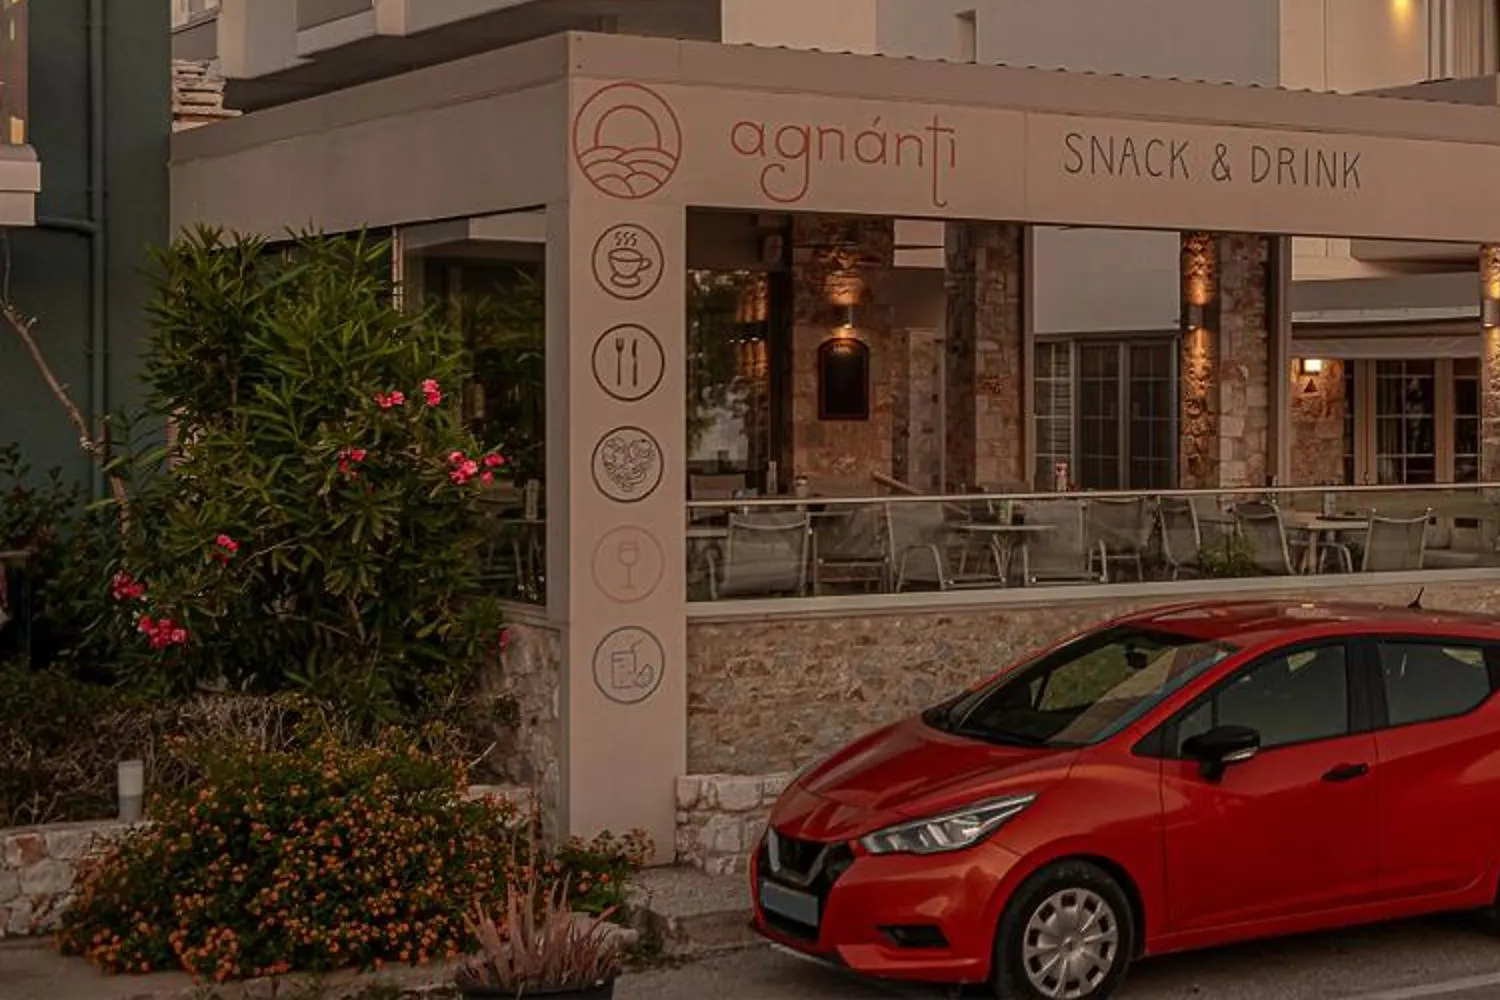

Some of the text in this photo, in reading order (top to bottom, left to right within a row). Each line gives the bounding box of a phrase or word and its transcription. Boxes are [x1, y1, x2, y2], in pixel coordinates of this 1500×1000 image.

[731, 115, 955, 208] agnánti
[1064, 132, 1361, 189] SNACK & DRINK
